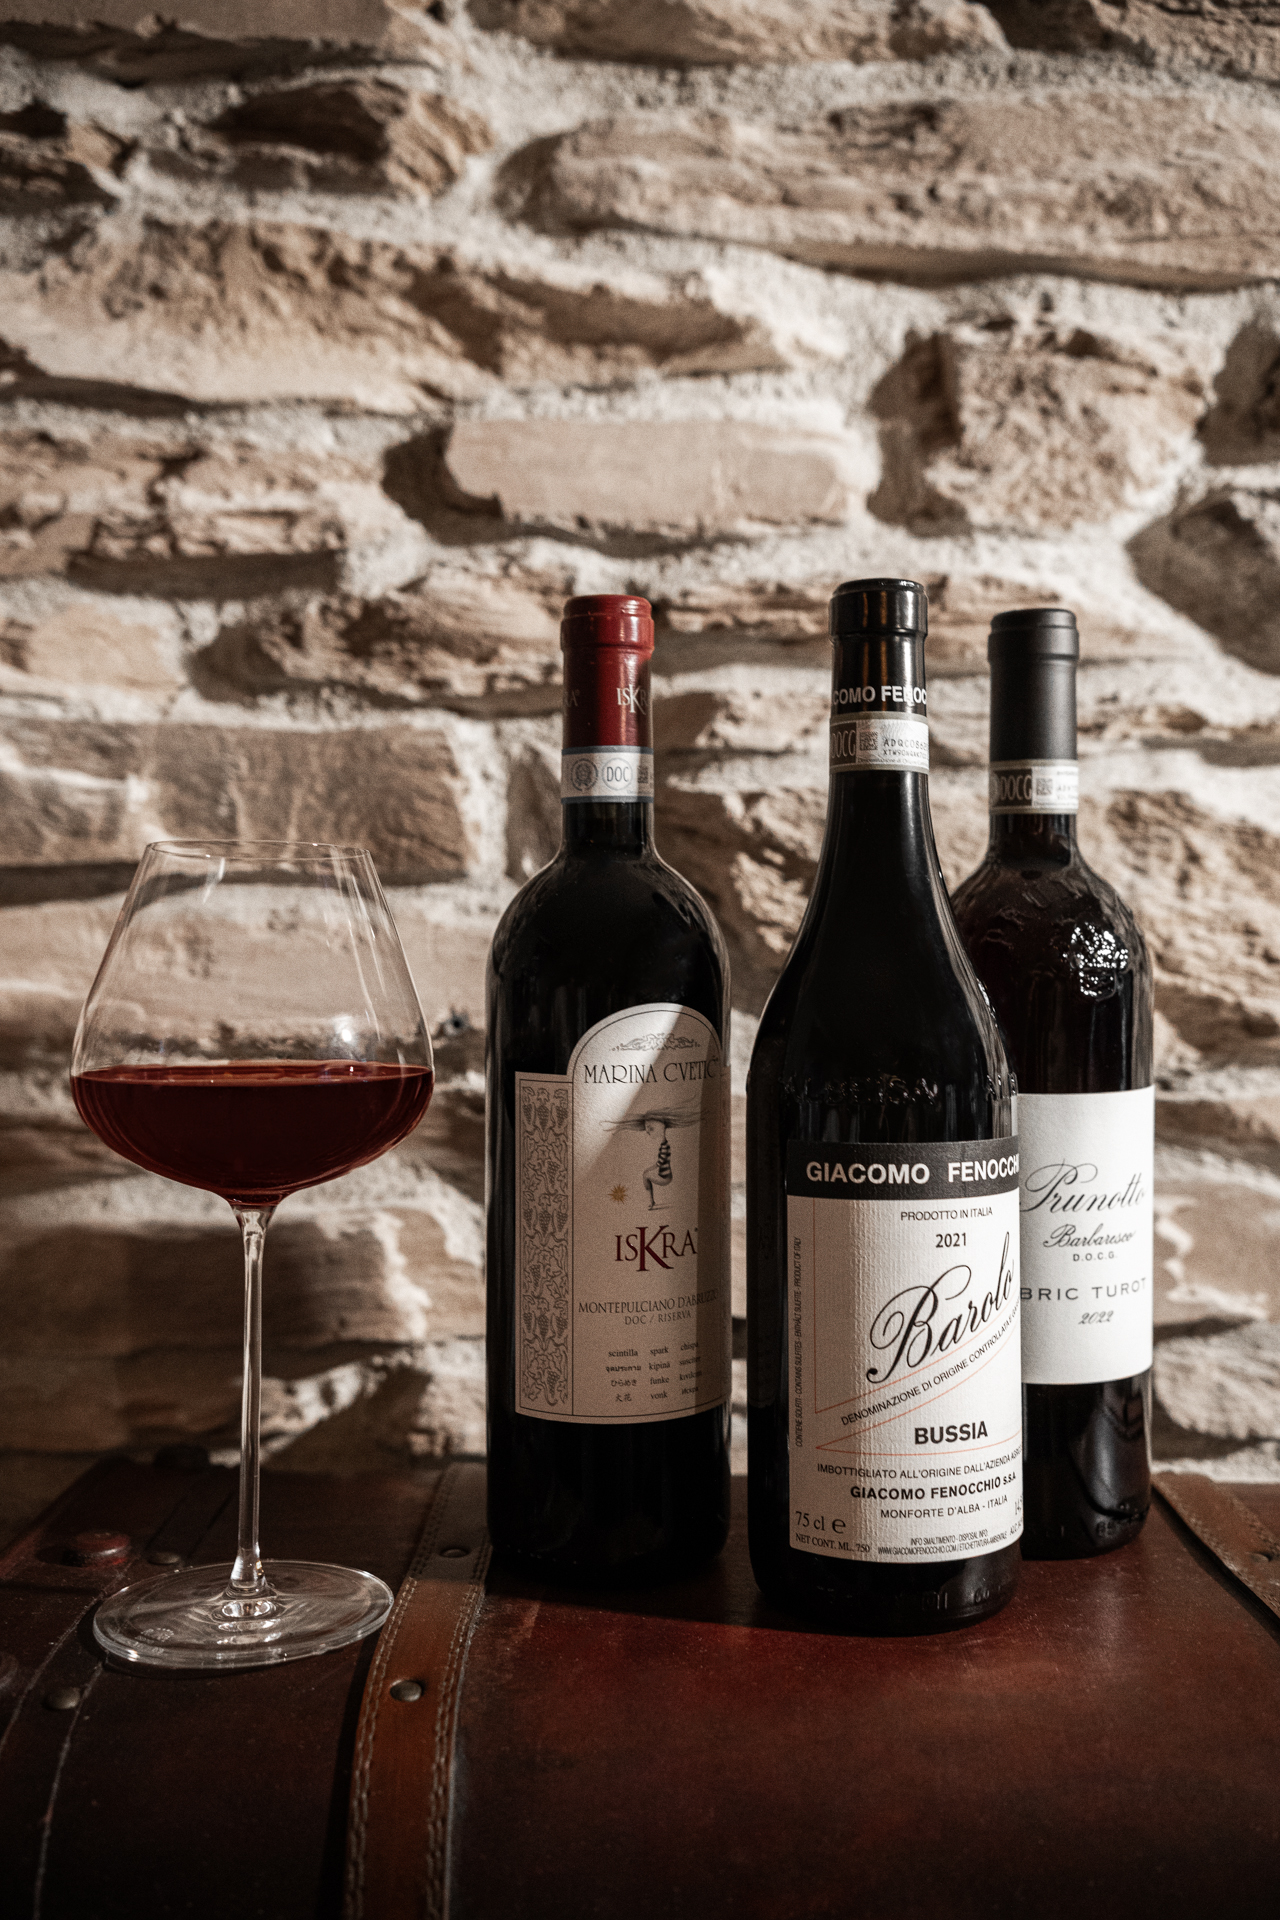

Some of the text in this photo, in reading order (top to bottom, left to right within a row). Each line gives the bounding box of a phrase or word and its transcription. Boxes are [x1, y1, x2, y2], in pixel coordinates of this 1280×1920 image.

[615, 684, 650, 715] ISKR
[833, 685, 927, 706] COMO FENOC
[606, 765, 630, 783] DOC
[583, 1064, 658, 1084] MARINA
[806, 1153, 1020, 1184] GIACOMO FENOCCH
[1019, 1158, 1147, 1214] Prunotto
[900, 1206, 993, 1221] PRODOTTO IN ITALIA
[935, 1232, 967, 1248] 2021
[1042, 1223, 1136, 1248] Barbaresco
[614, 1225, 698, 1272] ISKRA
[1019, 1277, 1147, 1301] BRIC TUROT
[578, 1298, 676, 1314] MONTEPULCIANO
[624, 1315, 647, 1325] DOC
[658, 1310, 692, 1323] RISERVA
[866, 1231, 1014, 1384] Barolo
[1078, 1310, 1115, 1325] 2022
[608, 1348, 639, 1357] scintilla
[649, 1346, 669, 1357] spark
[840, 1386, 922, 1426] DENOMINAZIONE
[921, 1380, 933, 1392] DI
[933, 1359, 969, 1386] ORIGINE
[914, 1421, 989, 1445] BUSSIA
[817, 1463, 897, 1479] IMBOTTIGLIATO
[899, 1467, 962, 1479] ALL'ORIGINE
[964, 1454, 1011, 1475] DALL'AZIENDA
[850, 1485, 926, 1500] GIACOMO
[930, 1476, 1001, 1499] FENOCCHIO
[880, 1508, 945, 1519] MONFORTE
[947, 1503, 981, 1516] D'ALBA
[987, 1494, 1008, 1510] ITALIA
[795, 1510, 810, 1528] 75
[813, 1515, 825, 1531] cl
[795, 1532, 811, 1545] NET
[811, 1536, 837, 1549] CONT.
[855, 1543, 871, 1553] 750
